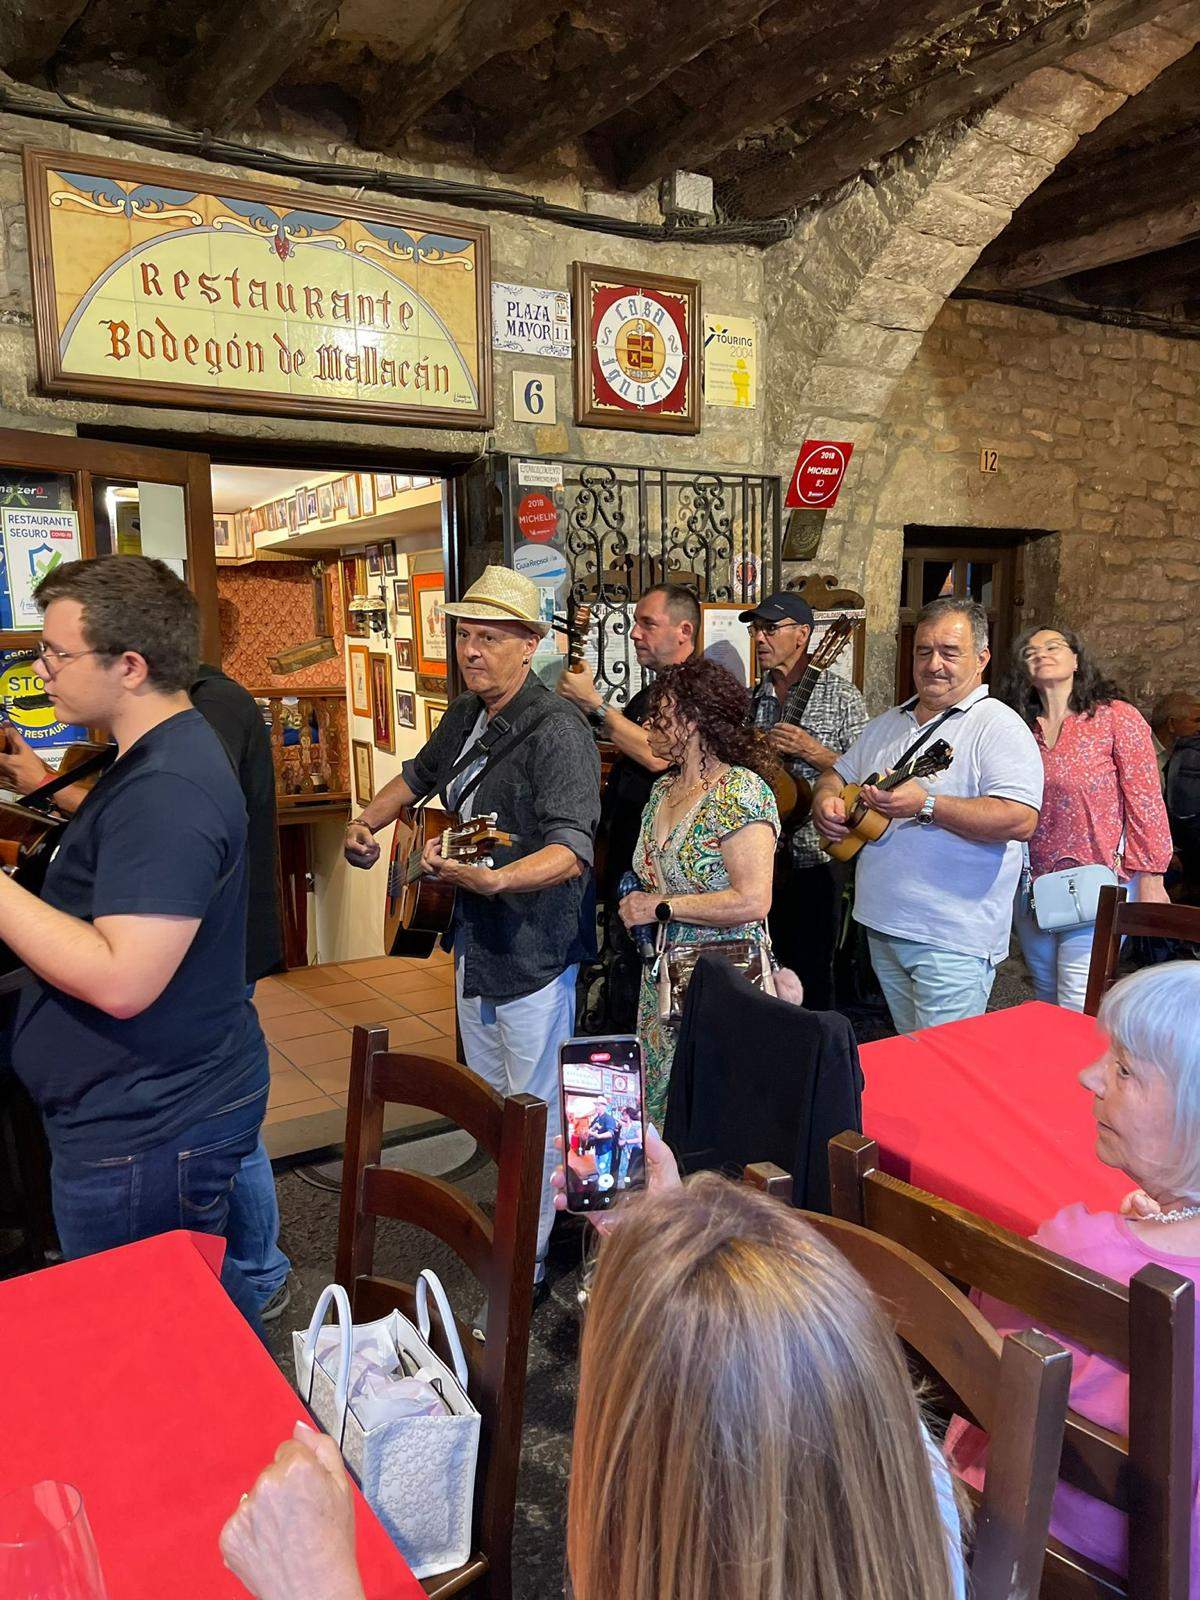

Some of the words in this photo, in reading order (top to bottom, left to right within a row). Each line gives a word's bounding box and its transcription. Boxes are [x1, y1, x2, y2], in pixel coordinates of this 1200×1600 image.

[140, 262, 414, 331] Restaurante
[507, 301, 551, 322] PLAZA
[506, 320, 552, 342] MAYOR
[716, 334, 753, 347] TOURING
[99, 317, 266, 376] Bodegón
[272, 333, 306, 376] de
[314, 343, 450, 394] Mallacán
[524, 379, 544, 415] 6
[984, 450, 997, 471] 12
[807, 466, 839, 475] MICHELIN
[8, 514, 73, 527] RESTAURANTE
[518, 512, 557, 524] MICHELIN
[9, 528, 48, 538] SEGURO
[8, 676, 46, 691] STO
